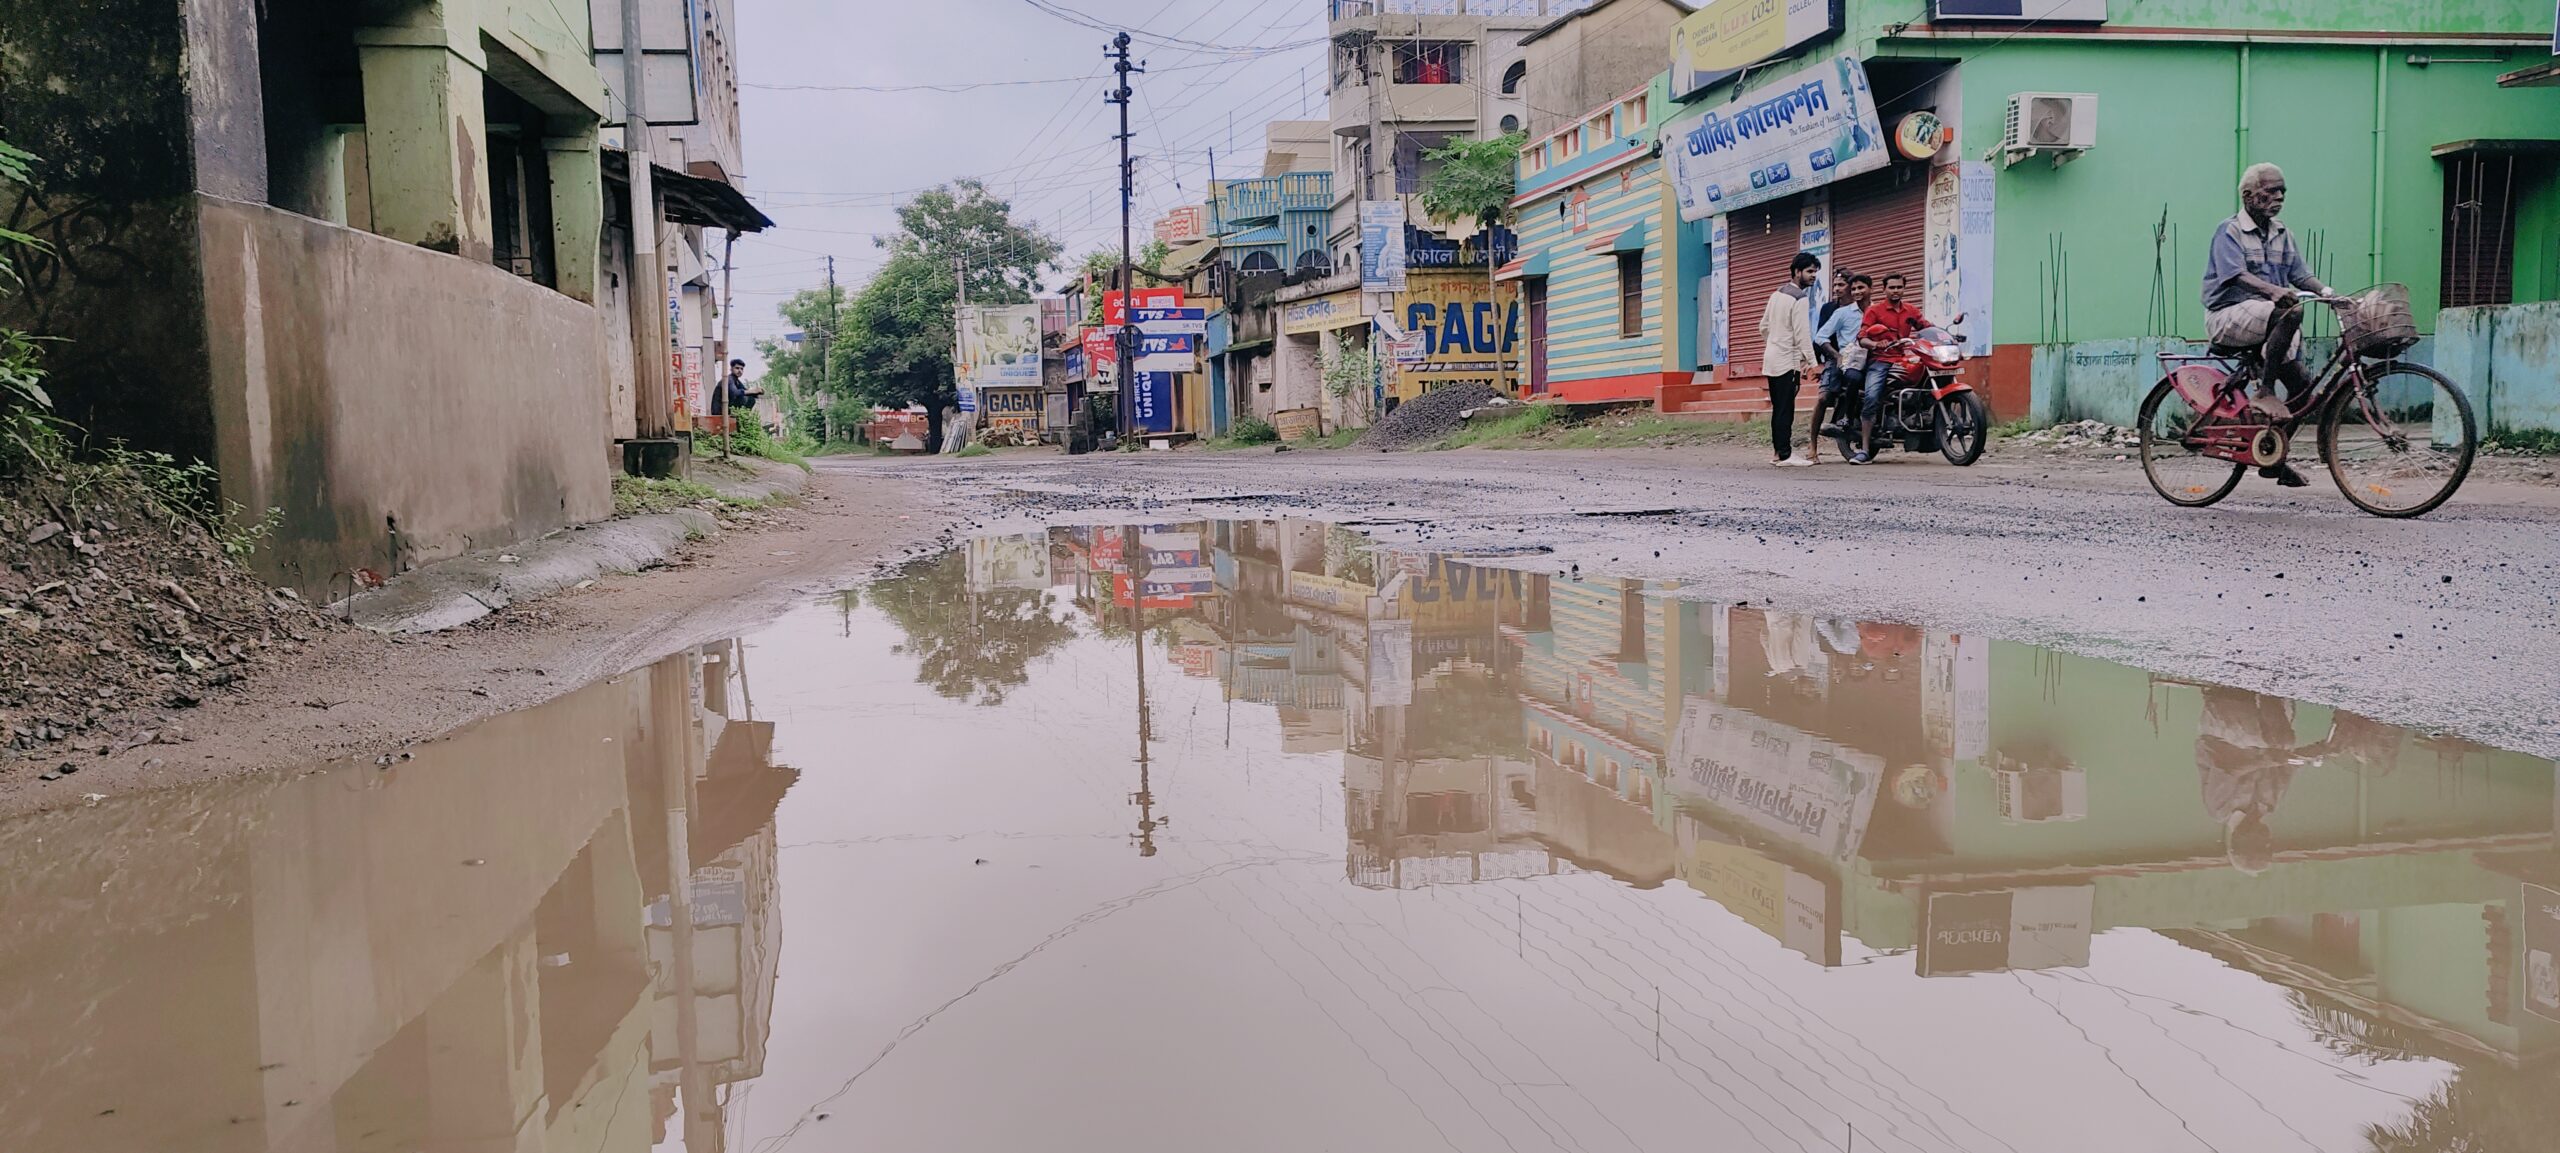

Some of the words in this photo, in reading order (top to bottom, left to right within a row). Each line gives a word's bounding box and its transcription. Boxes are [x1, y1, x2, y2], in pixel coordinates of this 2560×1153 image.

[1685, 112, 1737, 158] আবির
[1734, 79, 1830, 141] কালেকশন
[1799, 120, 1820, 135] Fashion
[1138, 310, 1165, 320] TVS
[1141, 338, 1168, 352] TVS
[989, 393, 1044, 412] GAGAN
